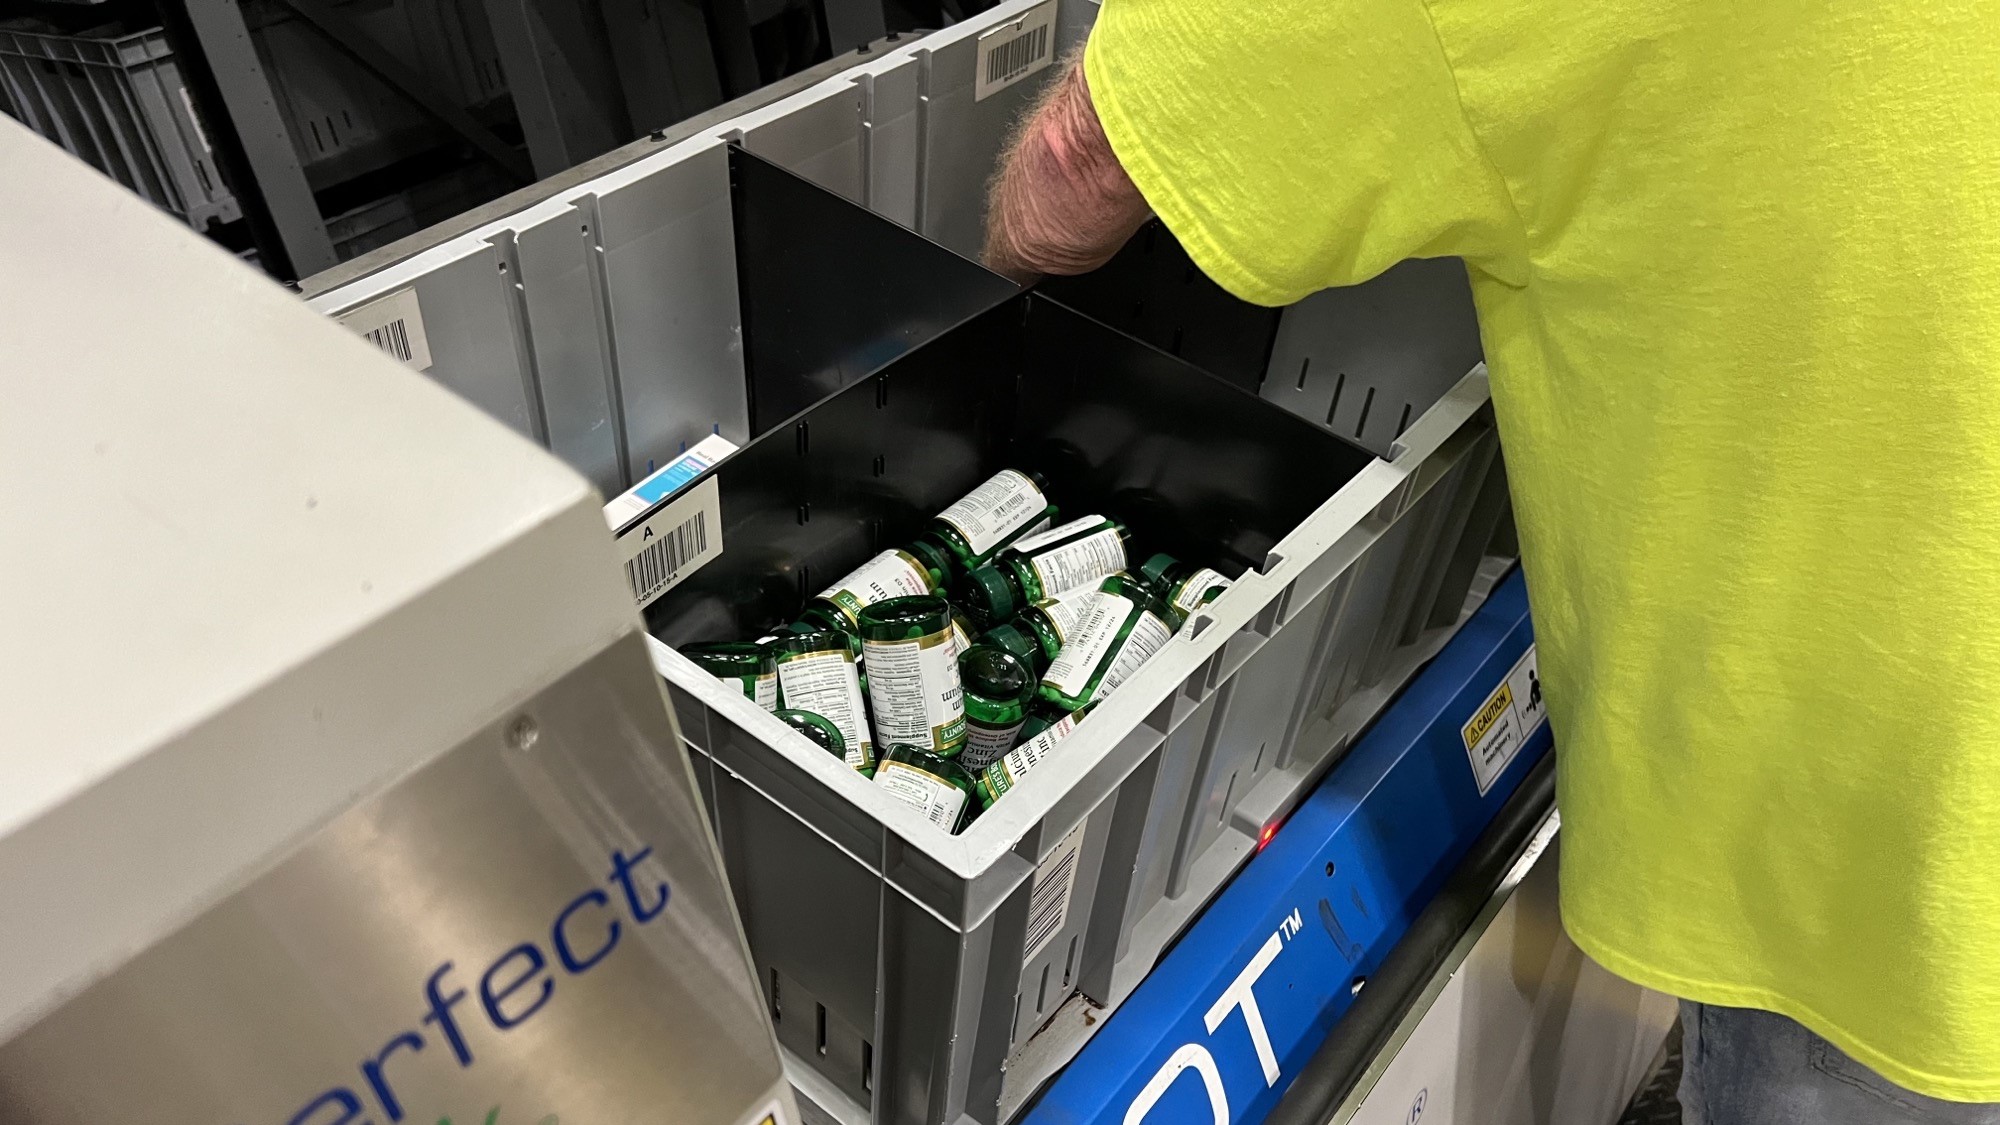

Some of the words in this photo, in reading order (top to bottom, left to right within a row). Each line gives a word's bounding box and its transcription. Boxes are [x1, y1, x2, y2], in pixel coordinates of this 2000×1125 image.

[643, 525, 654, 541] A
[1477, 691, 1507, 732] CAUTION
[1035, 735, 1050, 757] inc
[1482, 719, 1509, 757] Automated
[966, 746, 997, 758] Zinc
